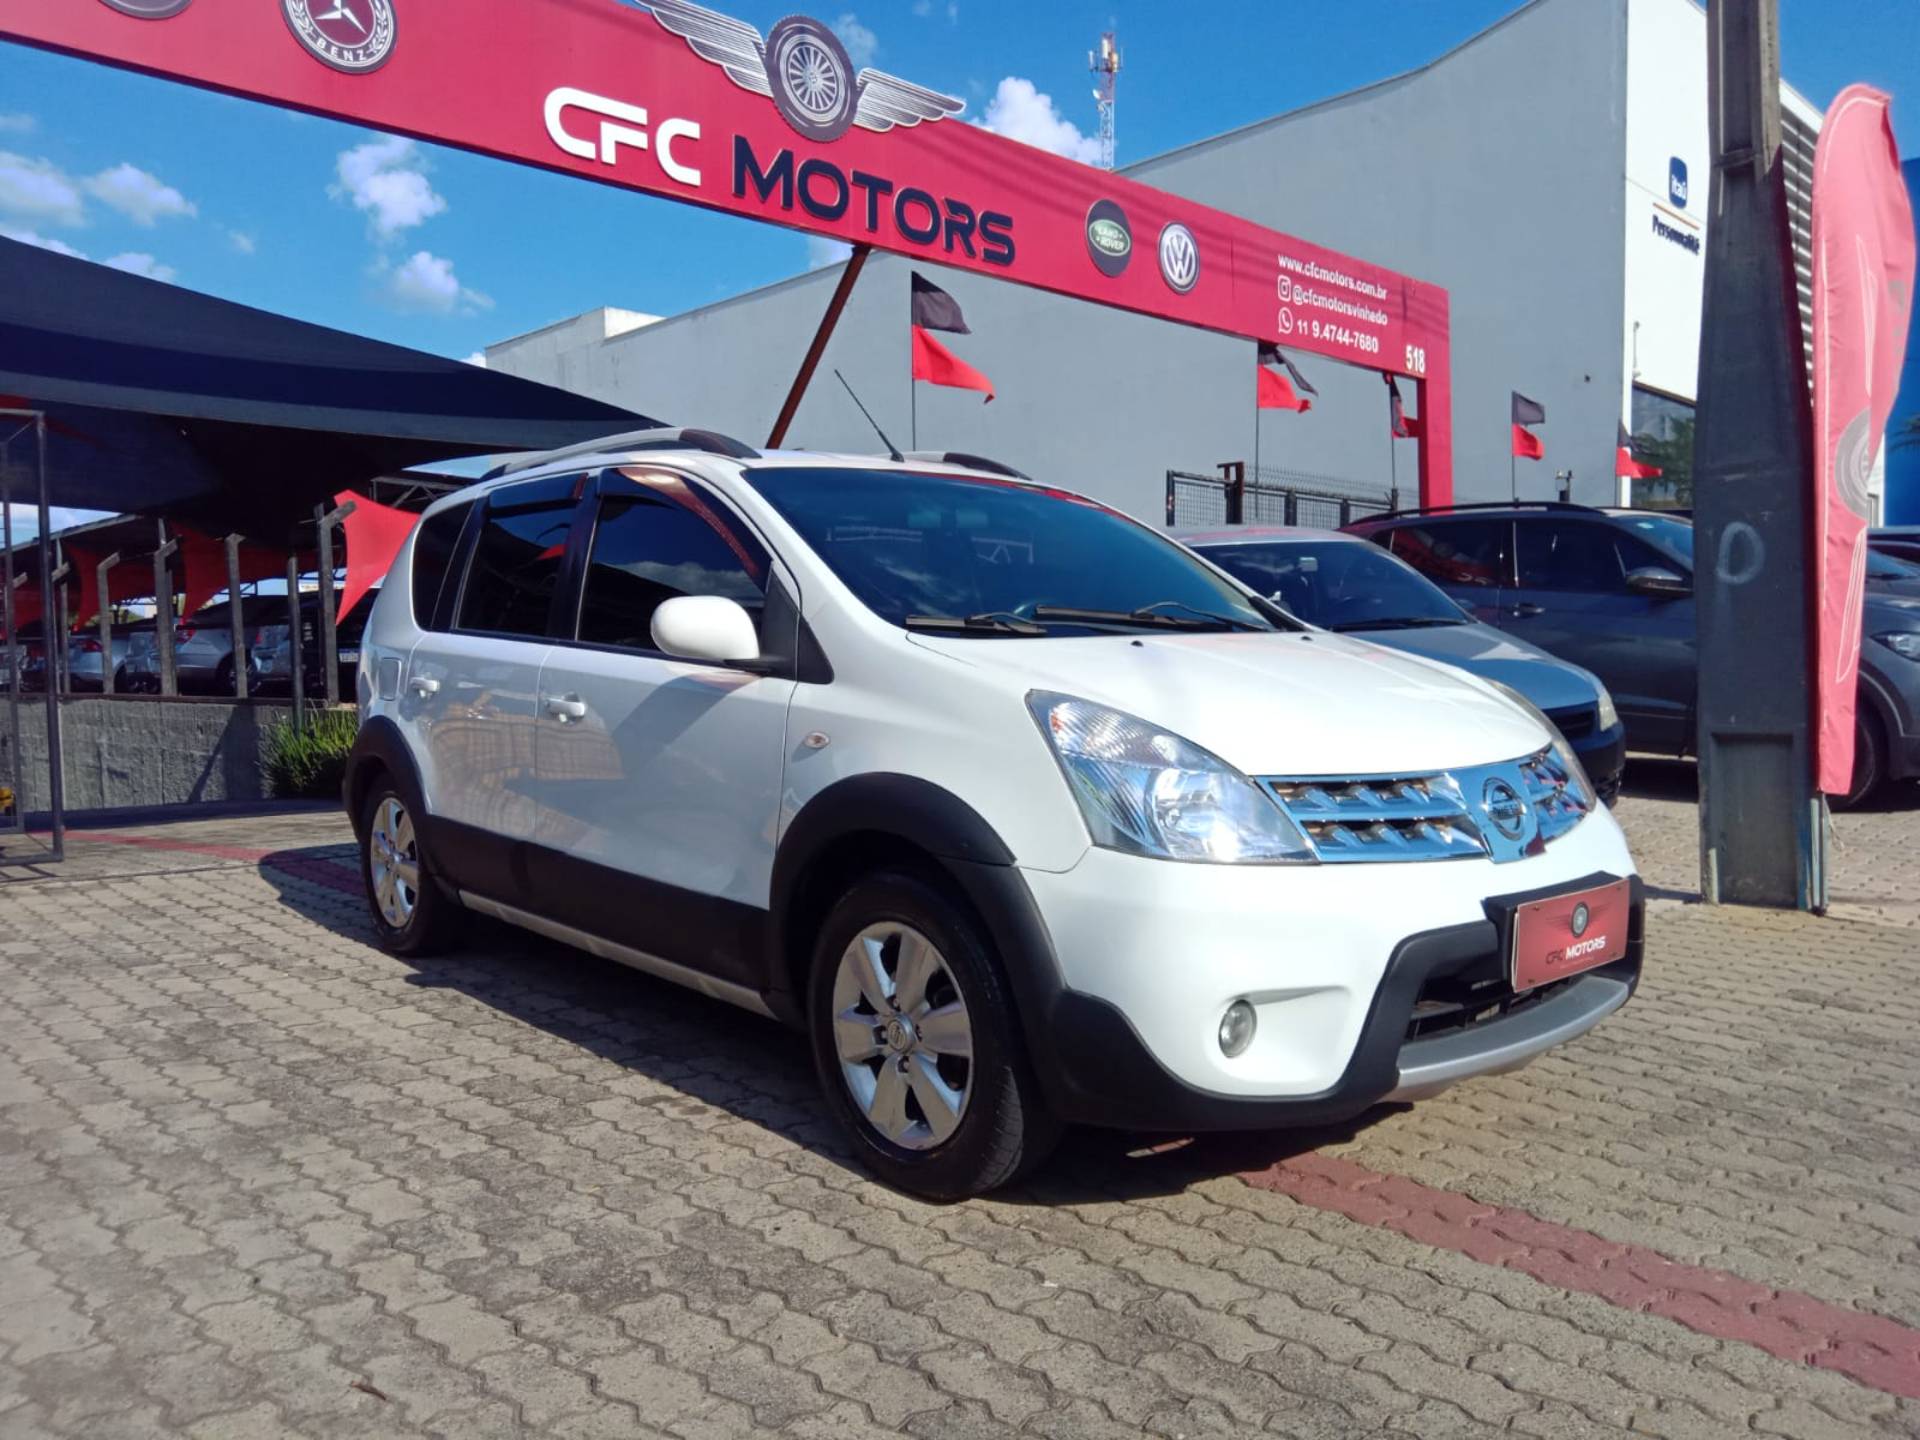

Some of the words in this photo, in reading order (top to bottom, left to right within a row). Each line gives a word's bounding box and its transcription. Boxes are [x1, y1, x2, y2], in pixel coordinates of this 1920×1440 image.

[316, 37, 368, 61] BENZ
[544, 86, 701, 187] CFC
[732, 134, 1016, 266] MOTORS
[1099, 237, 1125, 251] ROVER
[1277, 254, 1388, 300] www.cfcmotors.com.br
[1293, 285, 1389, 326] @cfcmotorsvinhedo
[1297, 319, 1309, 335] 11
[1311, 320, 1379, 354] 9.4744-7680
[1405, 344, 1425, 374] 518
[1565, 935, 1607, 960] MOTORS
